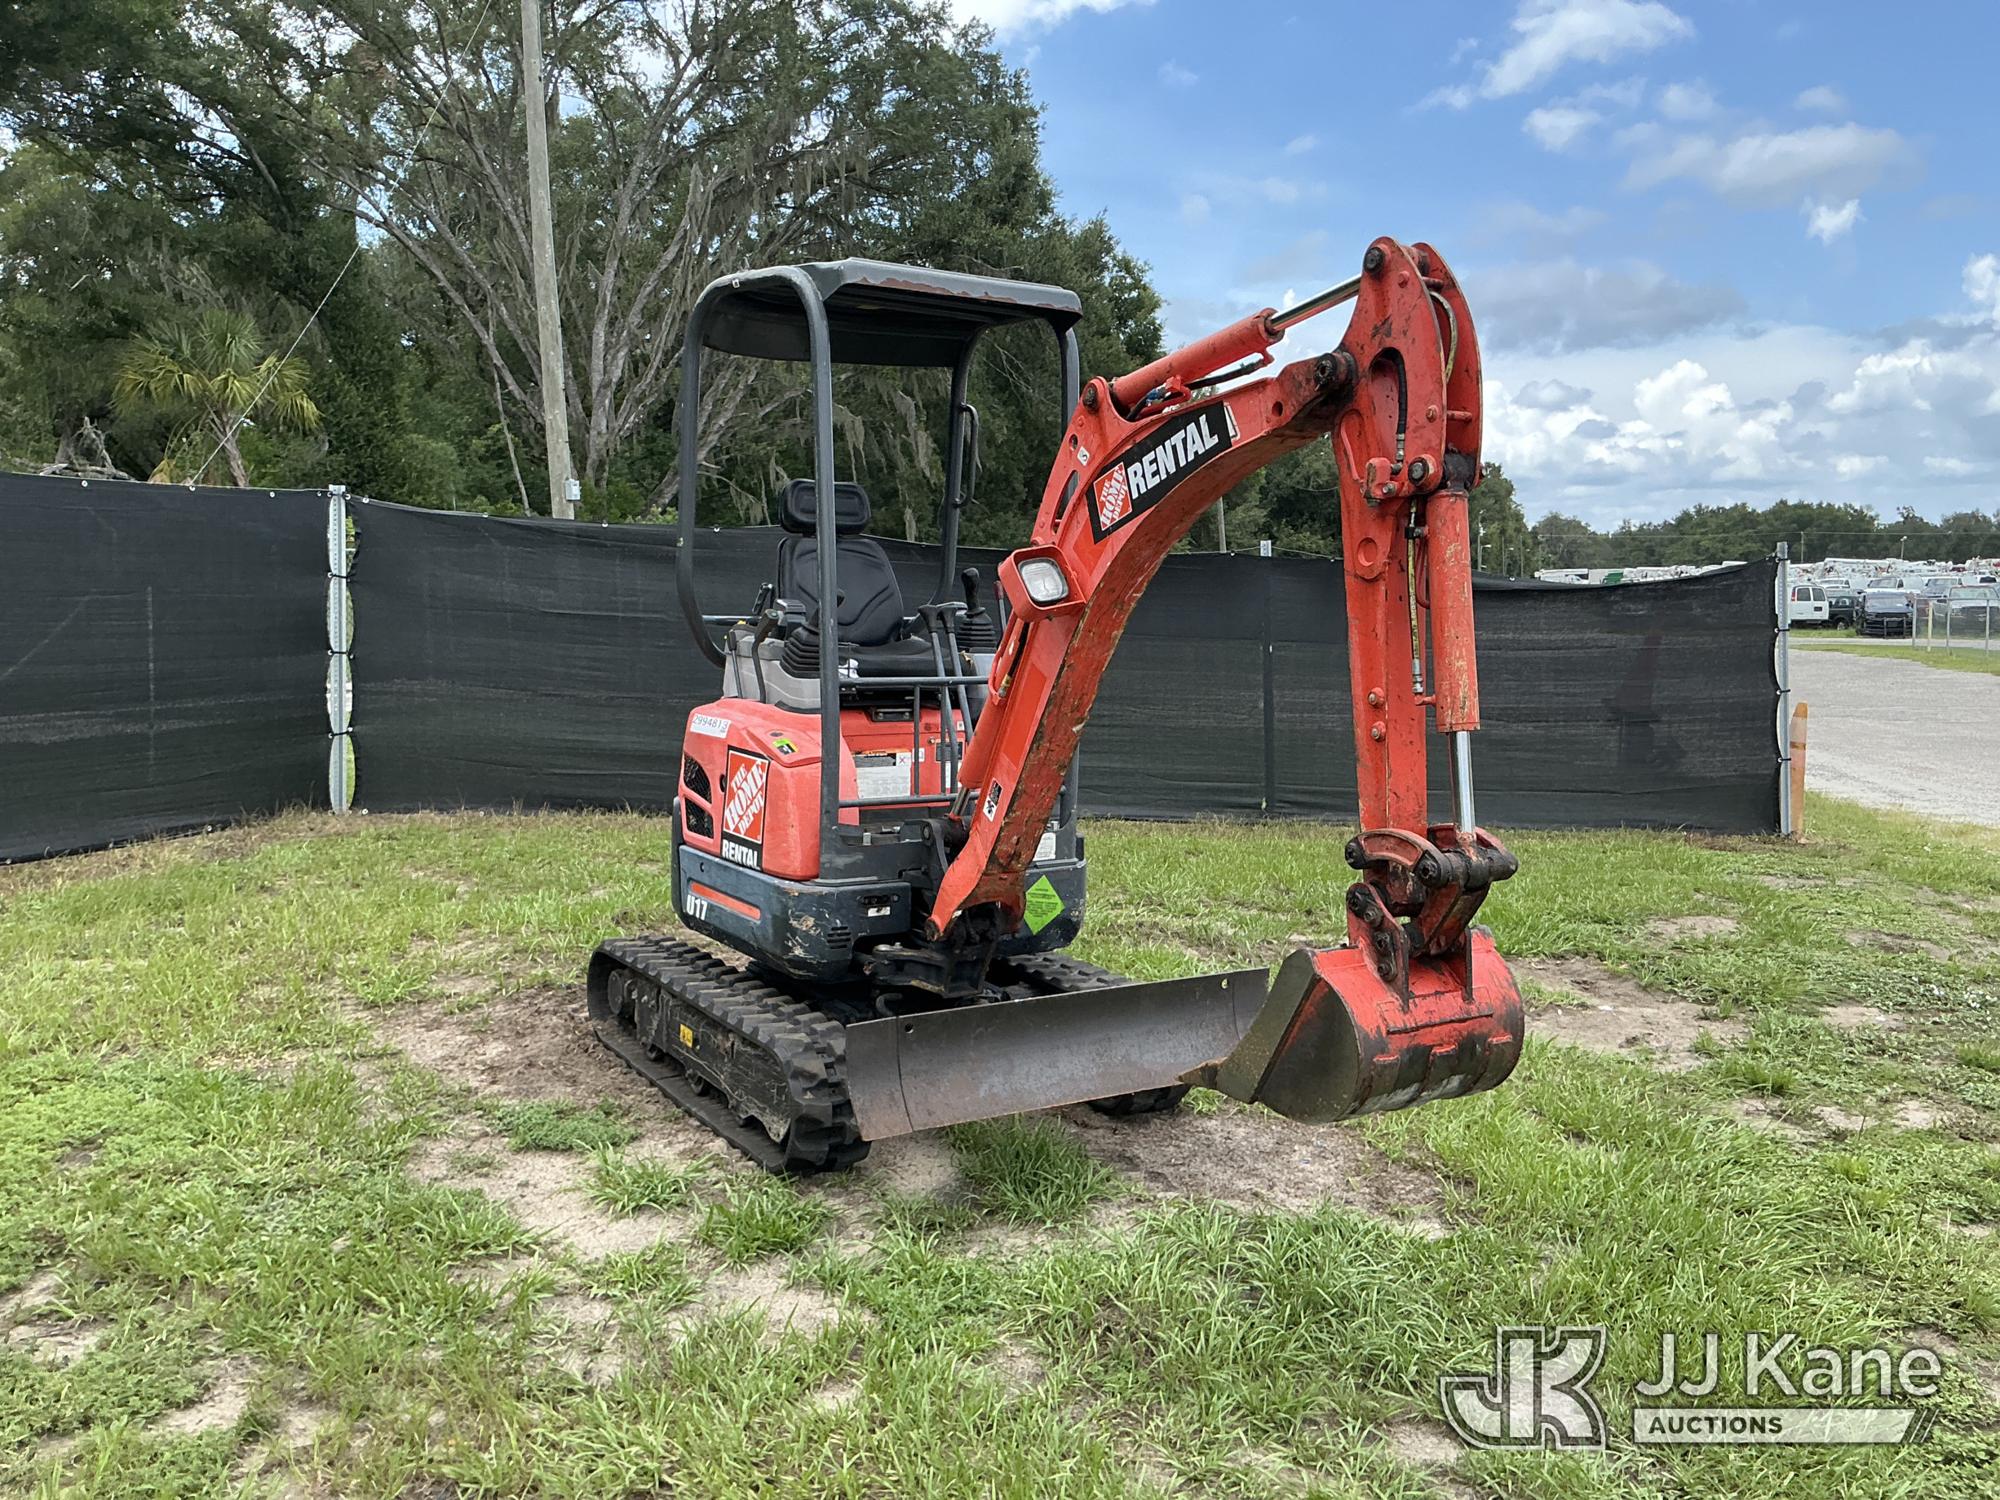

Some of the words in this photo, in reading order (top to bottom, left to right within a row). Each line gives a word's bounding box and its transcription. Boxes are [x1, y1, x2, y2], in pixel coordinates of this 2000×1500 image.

[1127, 414, 1219, 500] RENTAL
[1100, 465, 1125, 526] HOME
[725, 760, 768, 832] HOME
[731, 763, 748, 792] THE
[737, 792, 766, 836] DEPOT
[722, 839, 761, 870] RENTAL
[686, 894, 708, 921] U17
